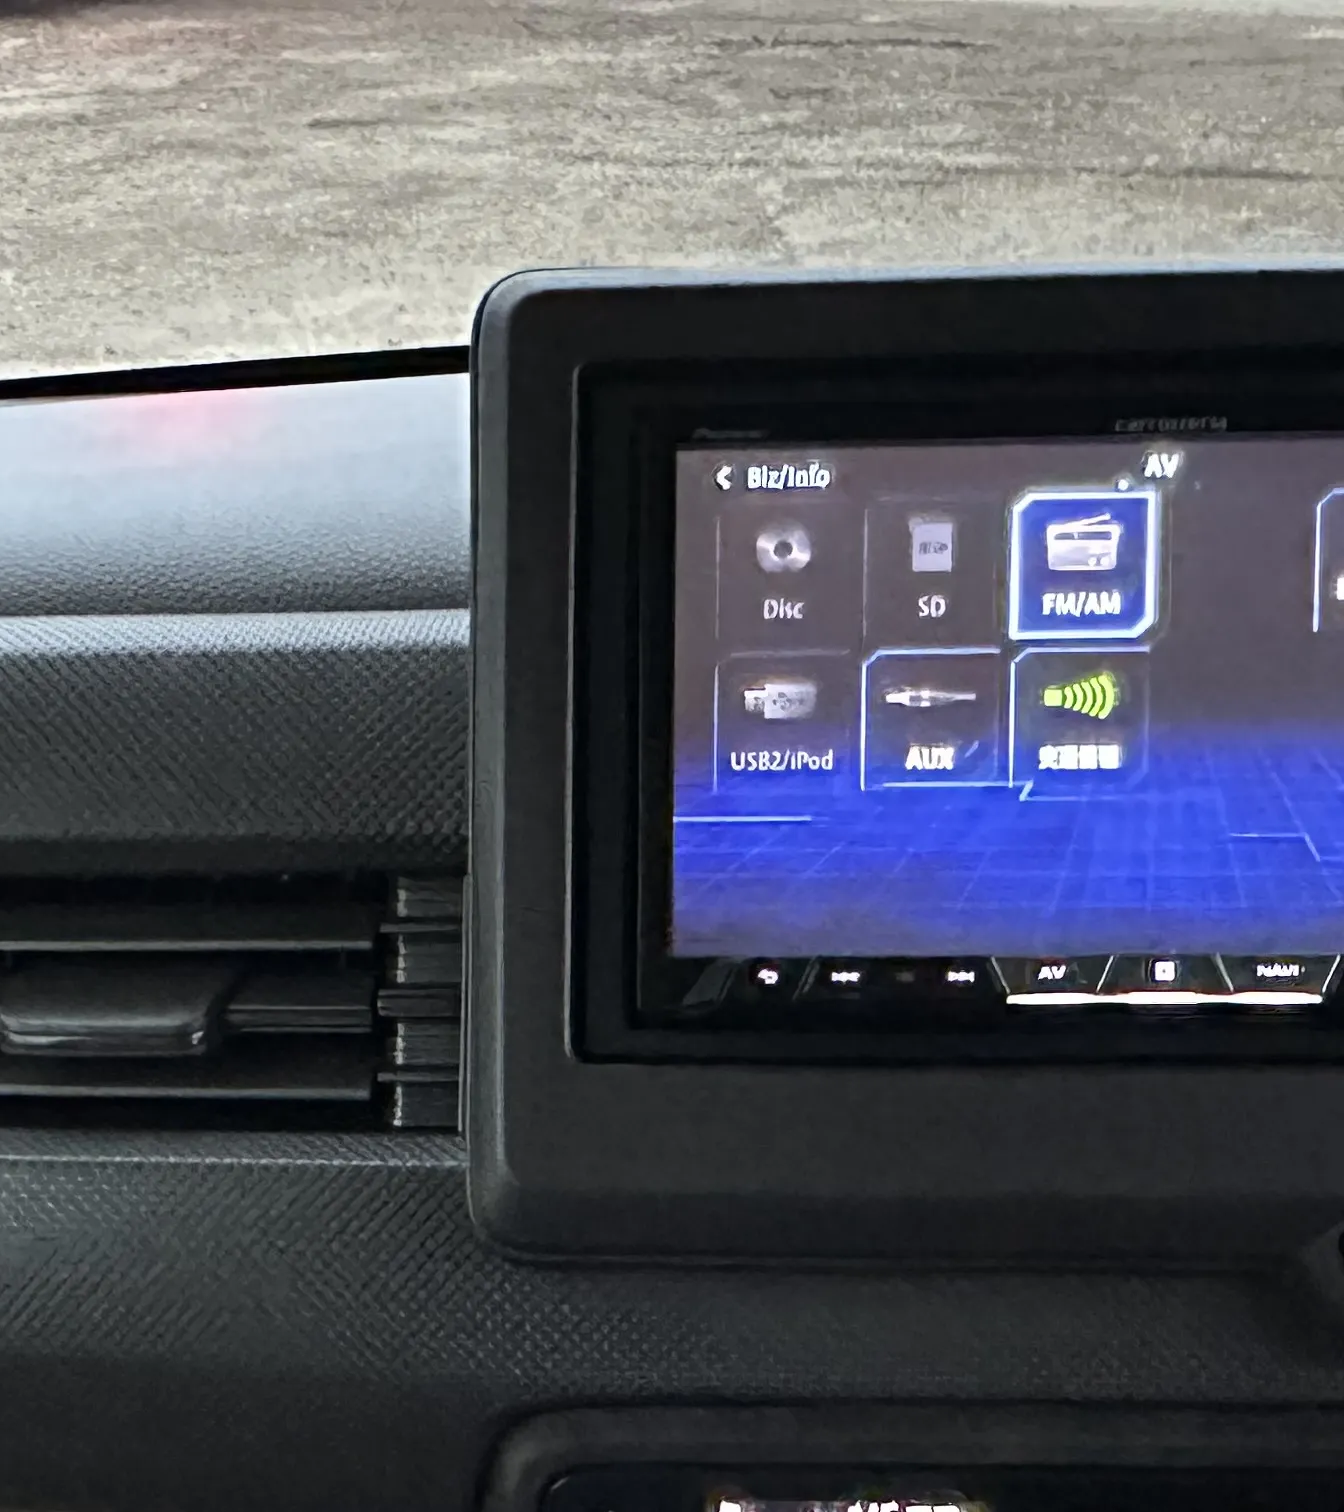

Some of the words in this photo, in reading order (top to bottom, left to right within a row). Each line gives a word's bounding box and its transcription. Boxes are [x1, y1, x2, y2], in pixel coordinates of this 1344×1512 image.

[747, 461, 832, 489] Biz/Info
[1144, 453, 1181, 478] AV
[763, 598, 805, 619] Disc
[918, 595, 947, 617] SD
[1042, 591, 1122, 617] FM/AM
[730, 748, 835, 771] USB2/iPod
[905, 746, 955, 770] AUX
[1037, 965, 1067, 980] AV
